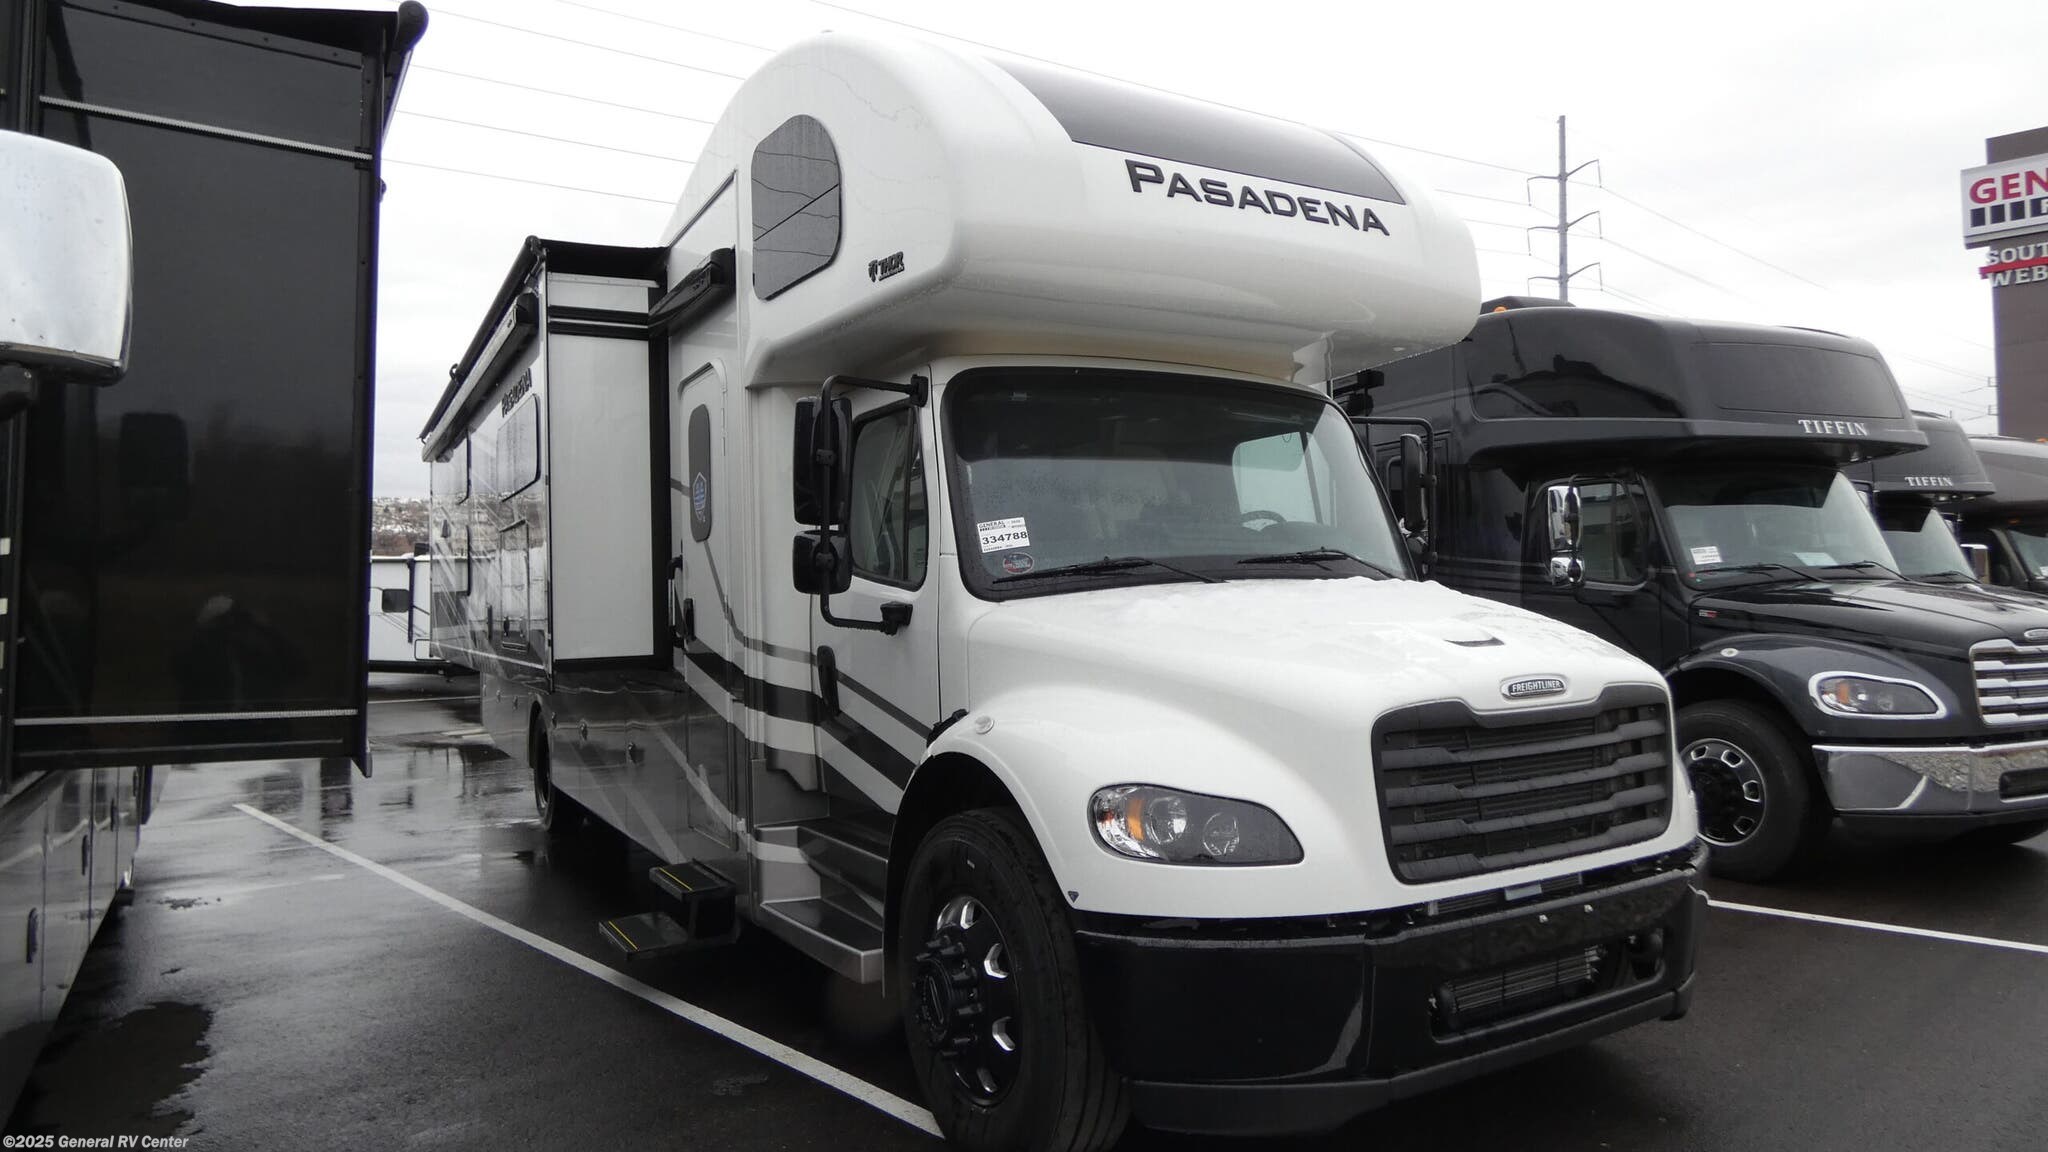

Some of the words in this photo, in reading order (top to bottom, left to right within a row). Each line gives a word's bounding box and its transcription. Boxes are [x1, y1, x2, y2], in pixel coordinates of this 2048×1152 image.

[1969, 167, 2048, 204] GEN
[1125, 159, 1390, 236] PASADENA
[878, 251, 905, 275] THOR
[1988, 265, 2048, 287] WEB
[1798, 420, 1868, 436] TIFFIN
[1905, 476, 1954, 487] TIFFIN
[982, 531, 1028, 545] 334788
[1512, 680, 1560, 692] FREIGHTLINER
